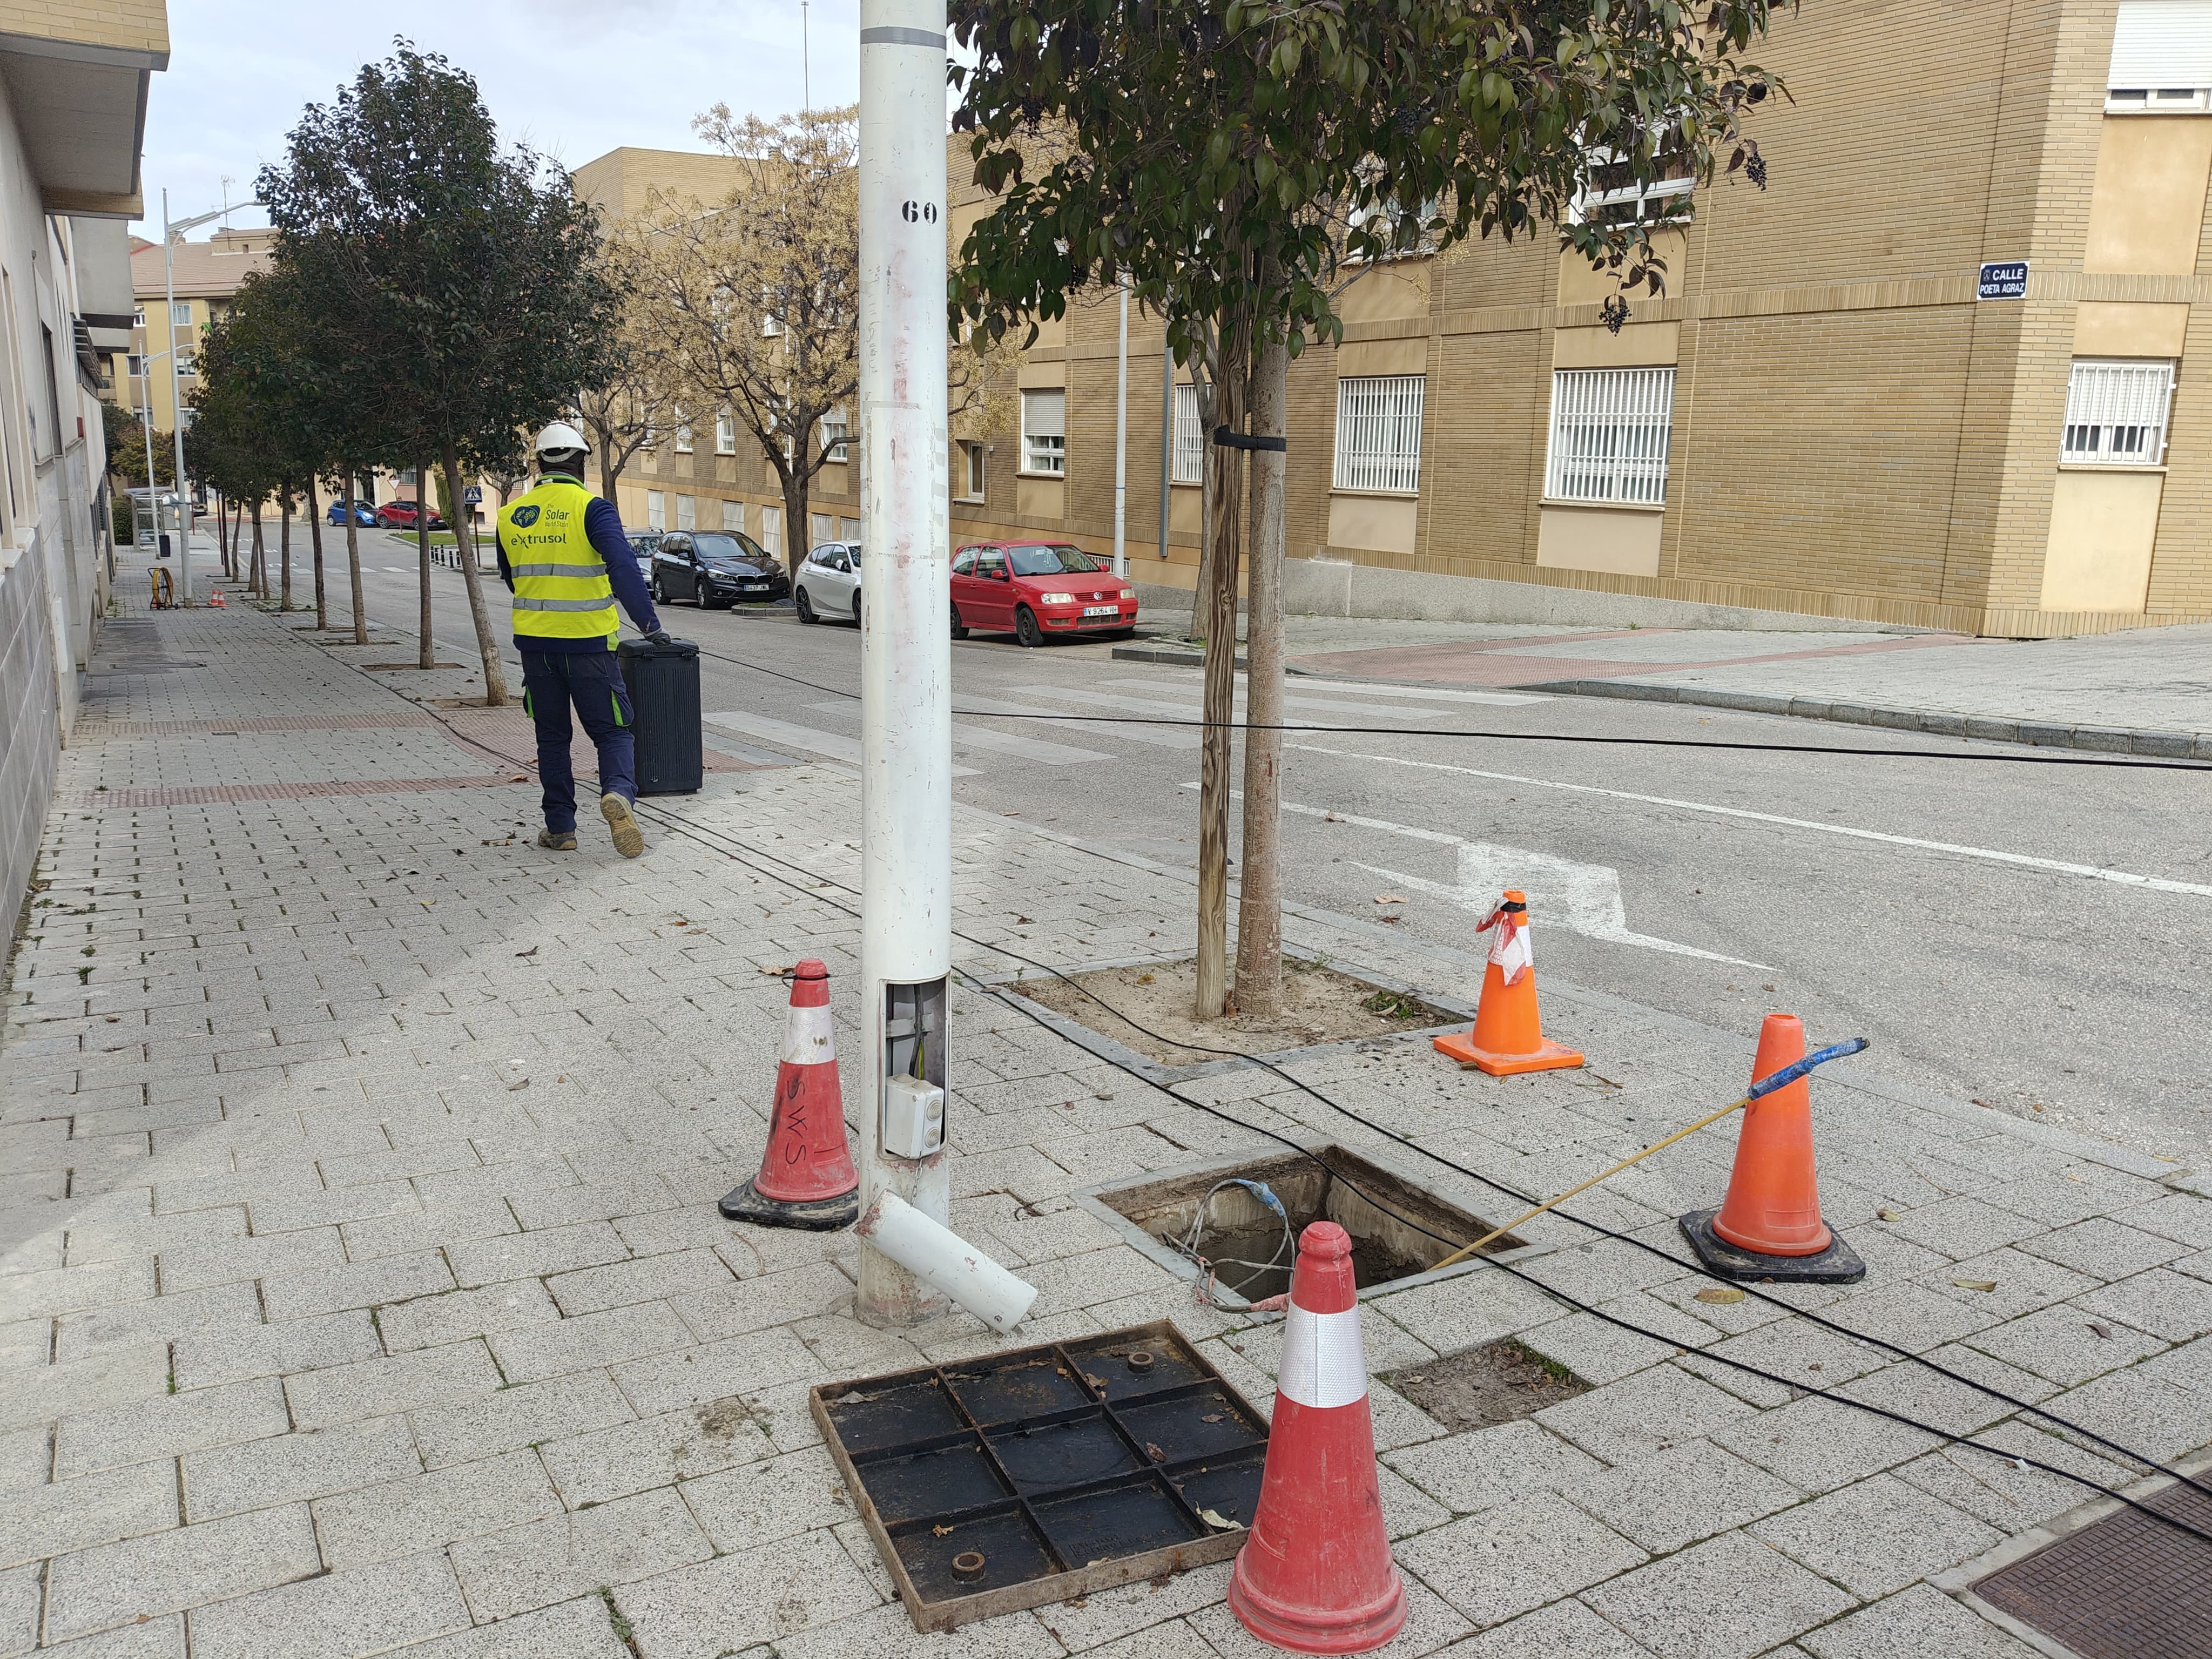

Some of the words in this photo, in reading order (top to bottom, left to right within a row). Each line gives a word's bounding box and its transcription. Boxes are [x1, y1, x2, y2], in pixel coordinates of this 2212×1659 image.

[902, 200, 937, 225] 60
[1992, 268, 2024, 281] CALLE
[1980, 284, 2000, 294] POETA
[2001, 282, 2025, 293] AGRAZ
[545, 509, 570, 520] Solar
[785, 1080, 808, 1165] SWS
